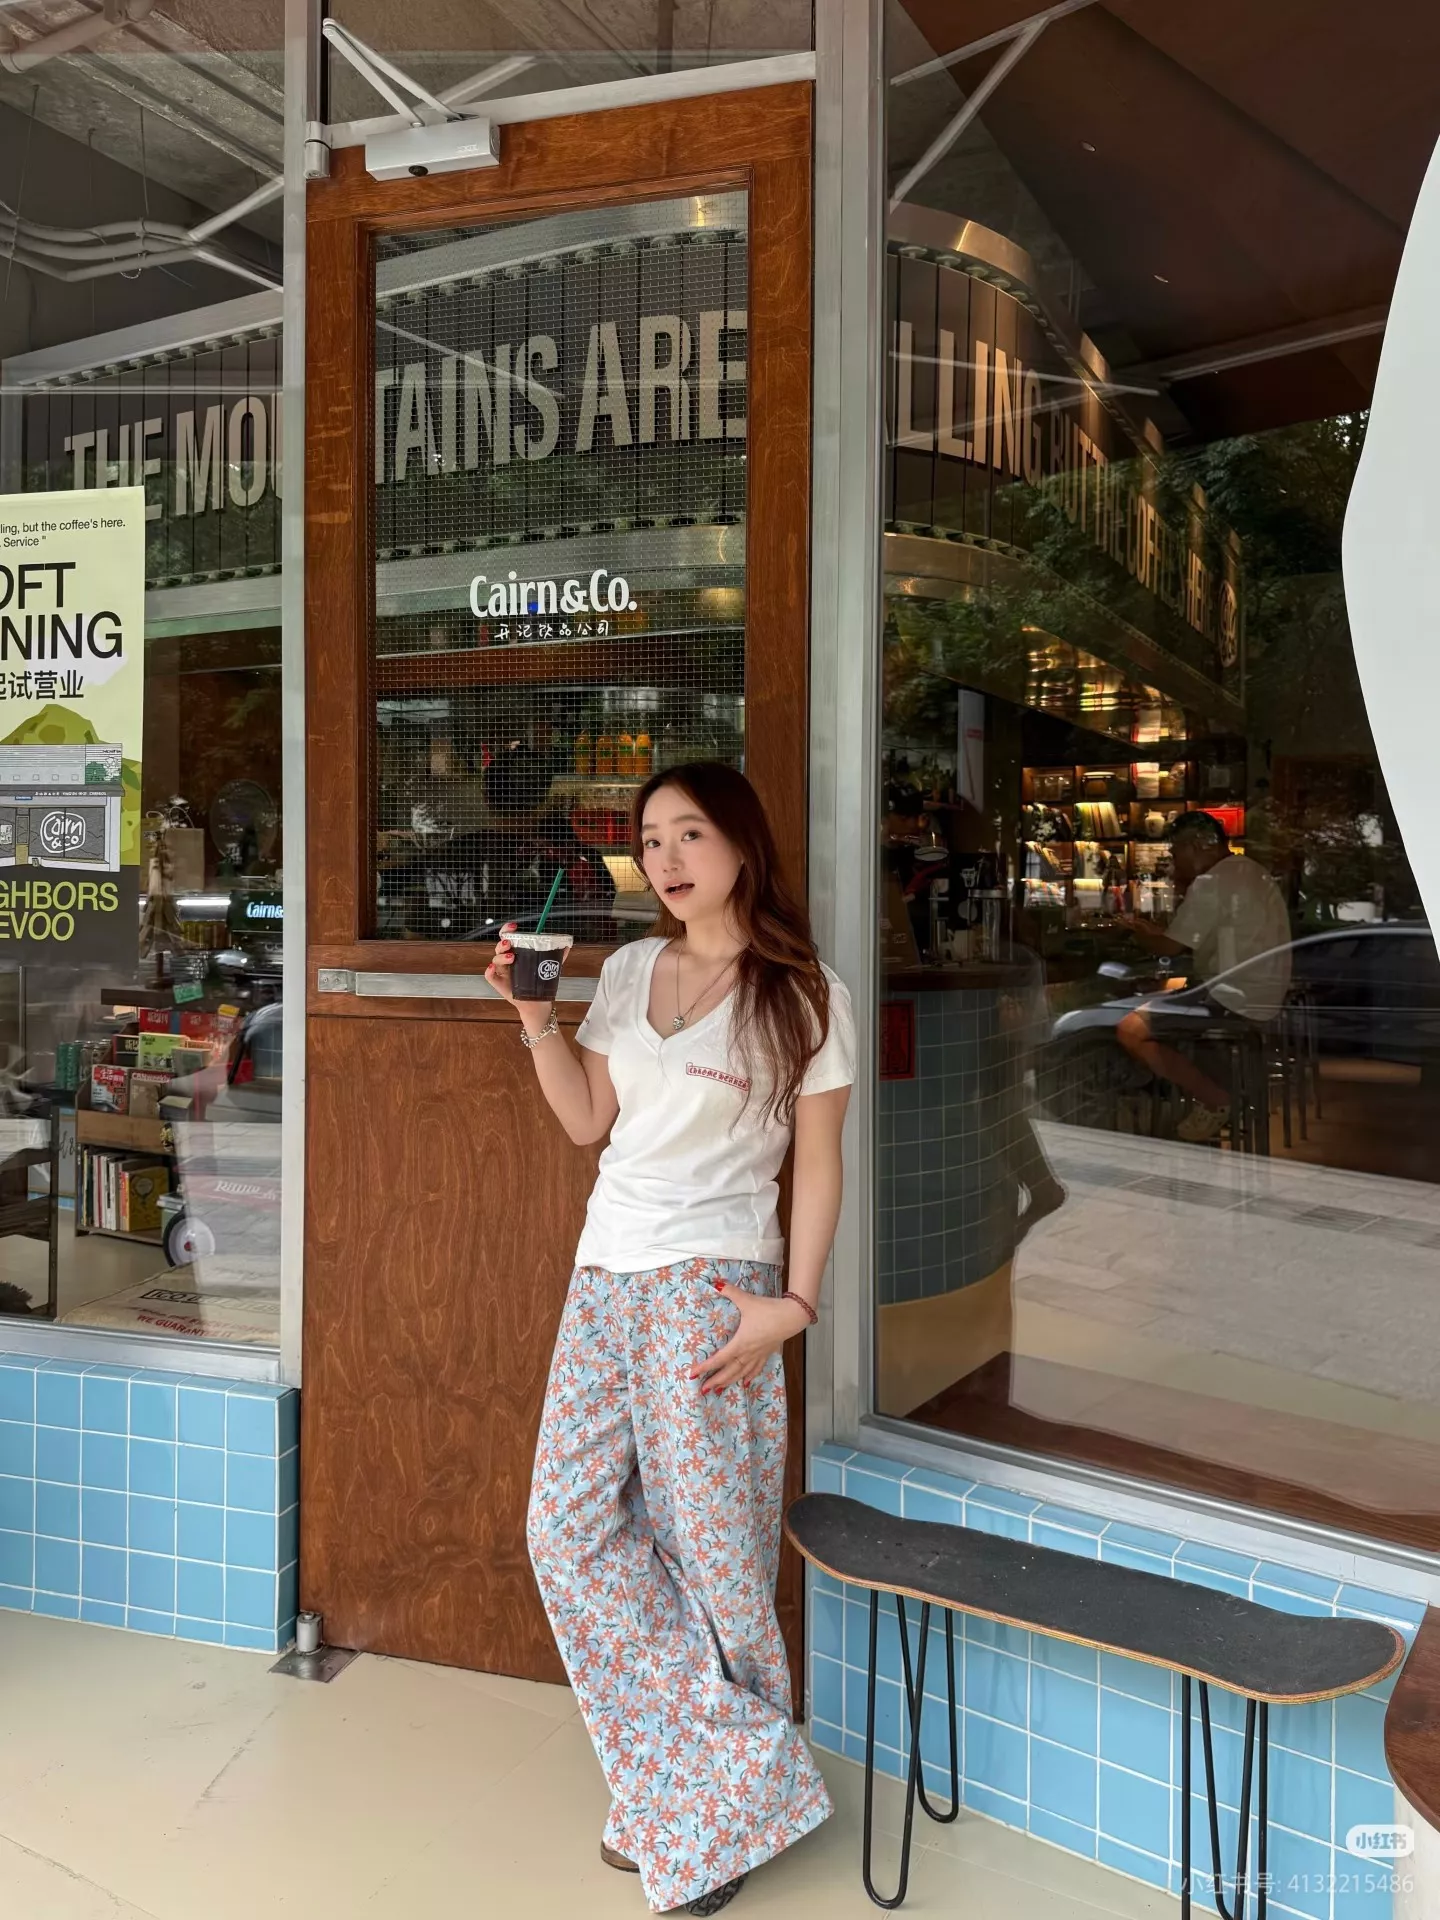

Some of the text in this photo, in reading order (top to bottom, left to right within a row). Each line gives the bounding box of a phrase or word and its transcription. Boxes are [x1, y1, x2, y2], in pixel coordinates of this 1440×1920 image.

[65, 417, 163, 522] THE
[576, 310, 748, 454] ARE
[885, 320, 1043, 490] LLING
[3, 534, 39, 548] Service
[22, 522, 39, 533] but
[41, 520, 57, 532] the
[59, 518, 99, 531] coffee's
[100, 517, 126, 528] here.
[470, 569, 638, 618] Cairn&Co.
[1, 611, 123, 660] NING
[0, 669, 84, 701] 试营业
[43, 815, 82, 841] Cairn
